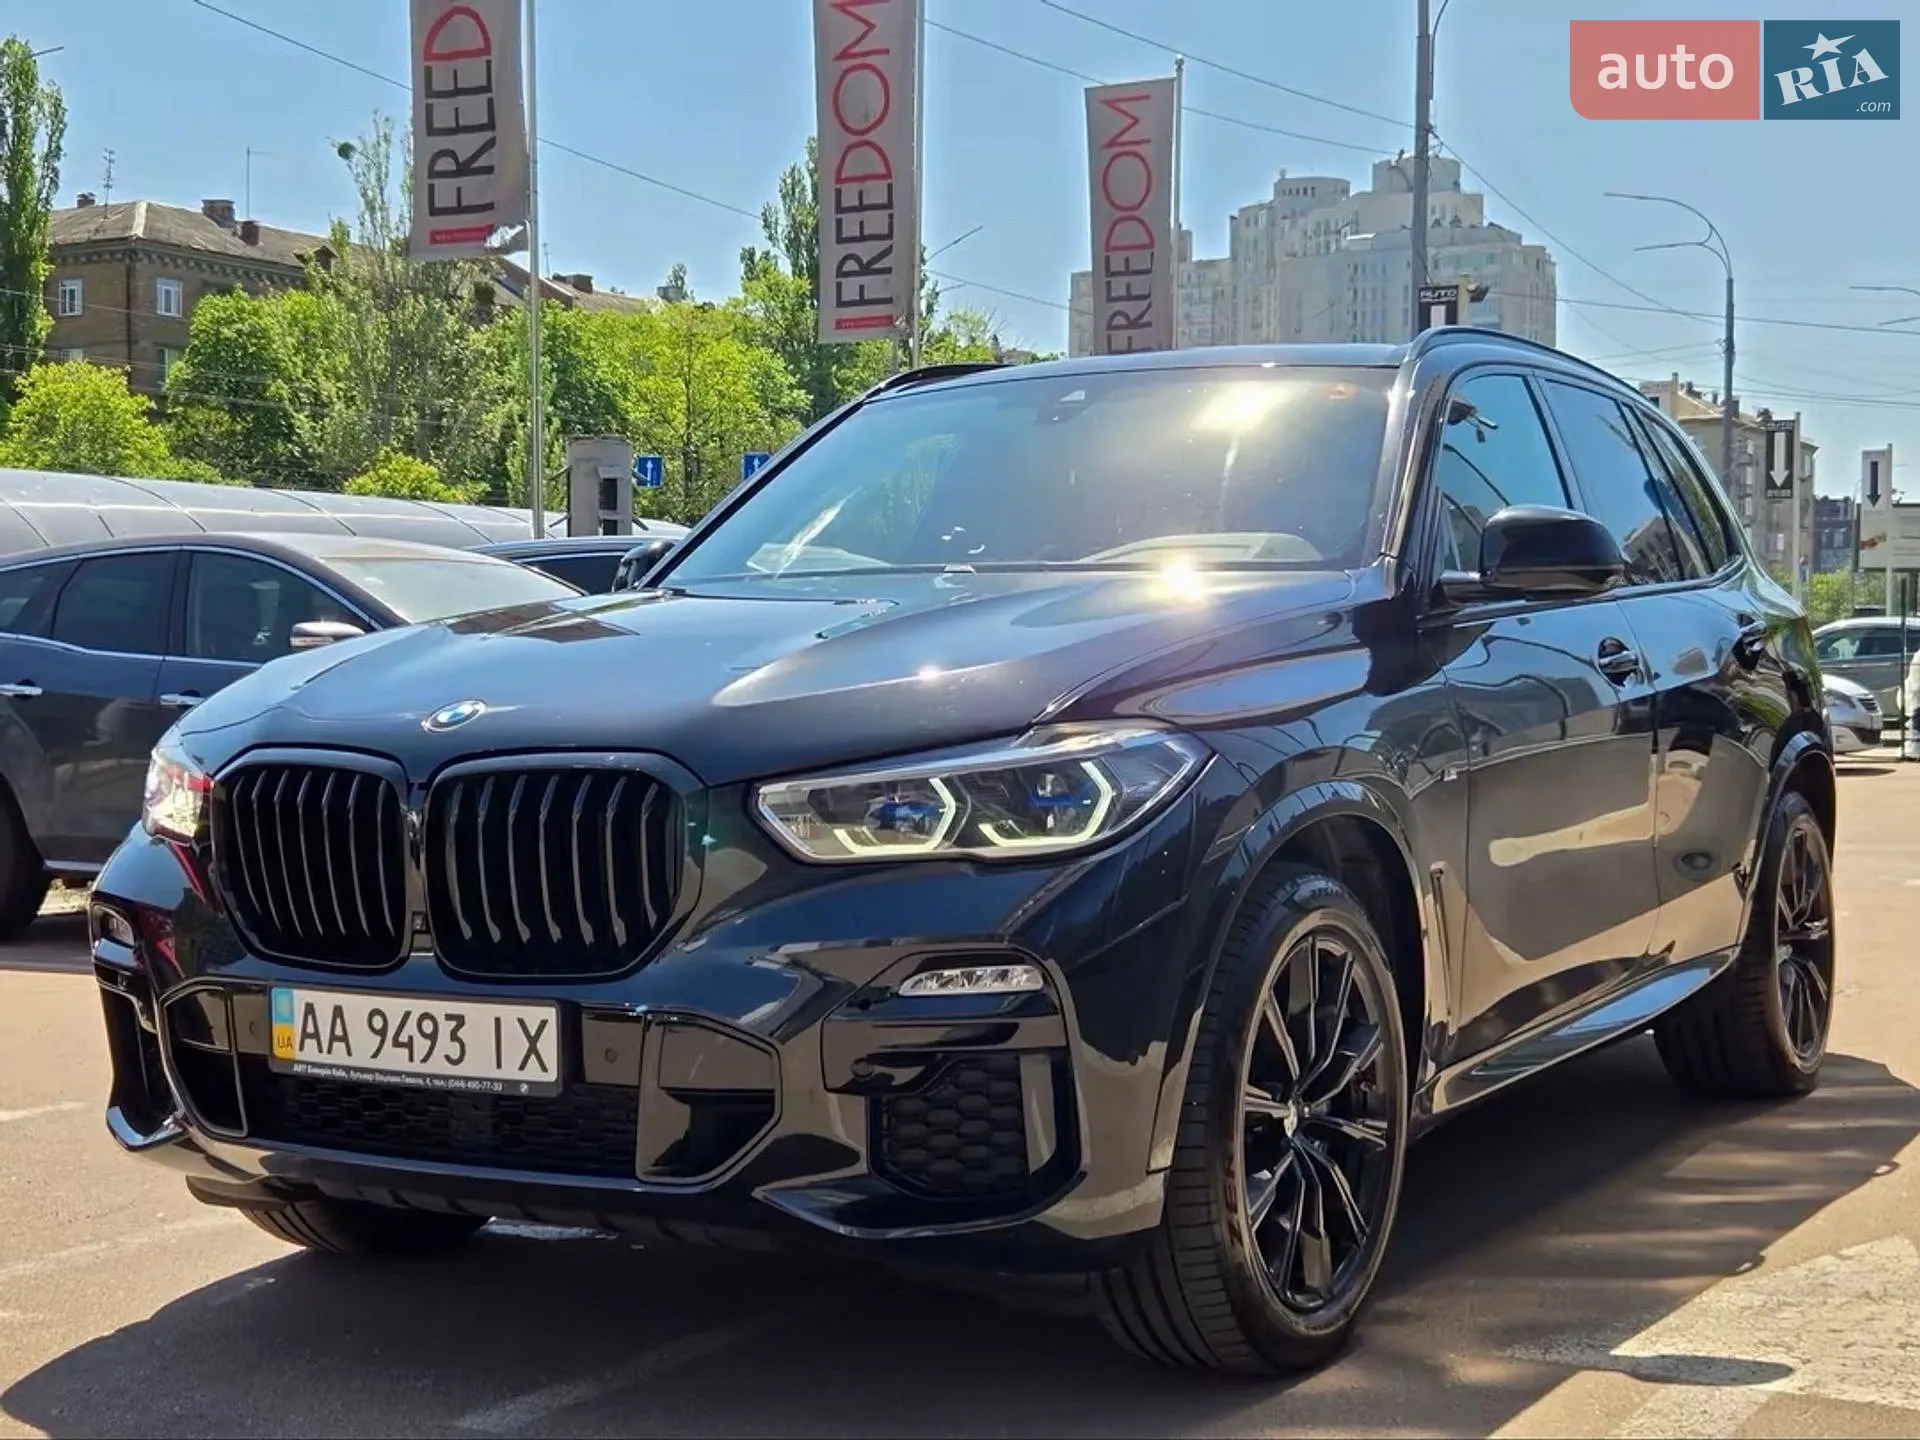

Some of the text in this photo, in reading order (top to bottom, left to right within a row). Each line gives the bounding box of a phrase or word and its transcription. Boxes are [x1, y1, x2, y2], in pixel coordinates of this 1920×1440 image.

[828, 0, 894, 309] FREEDOM
[277, 1034, 293, 1050] UA
[299, 1002, 353, 1057] AA
[367, 1007, 467, 1067] 9493
